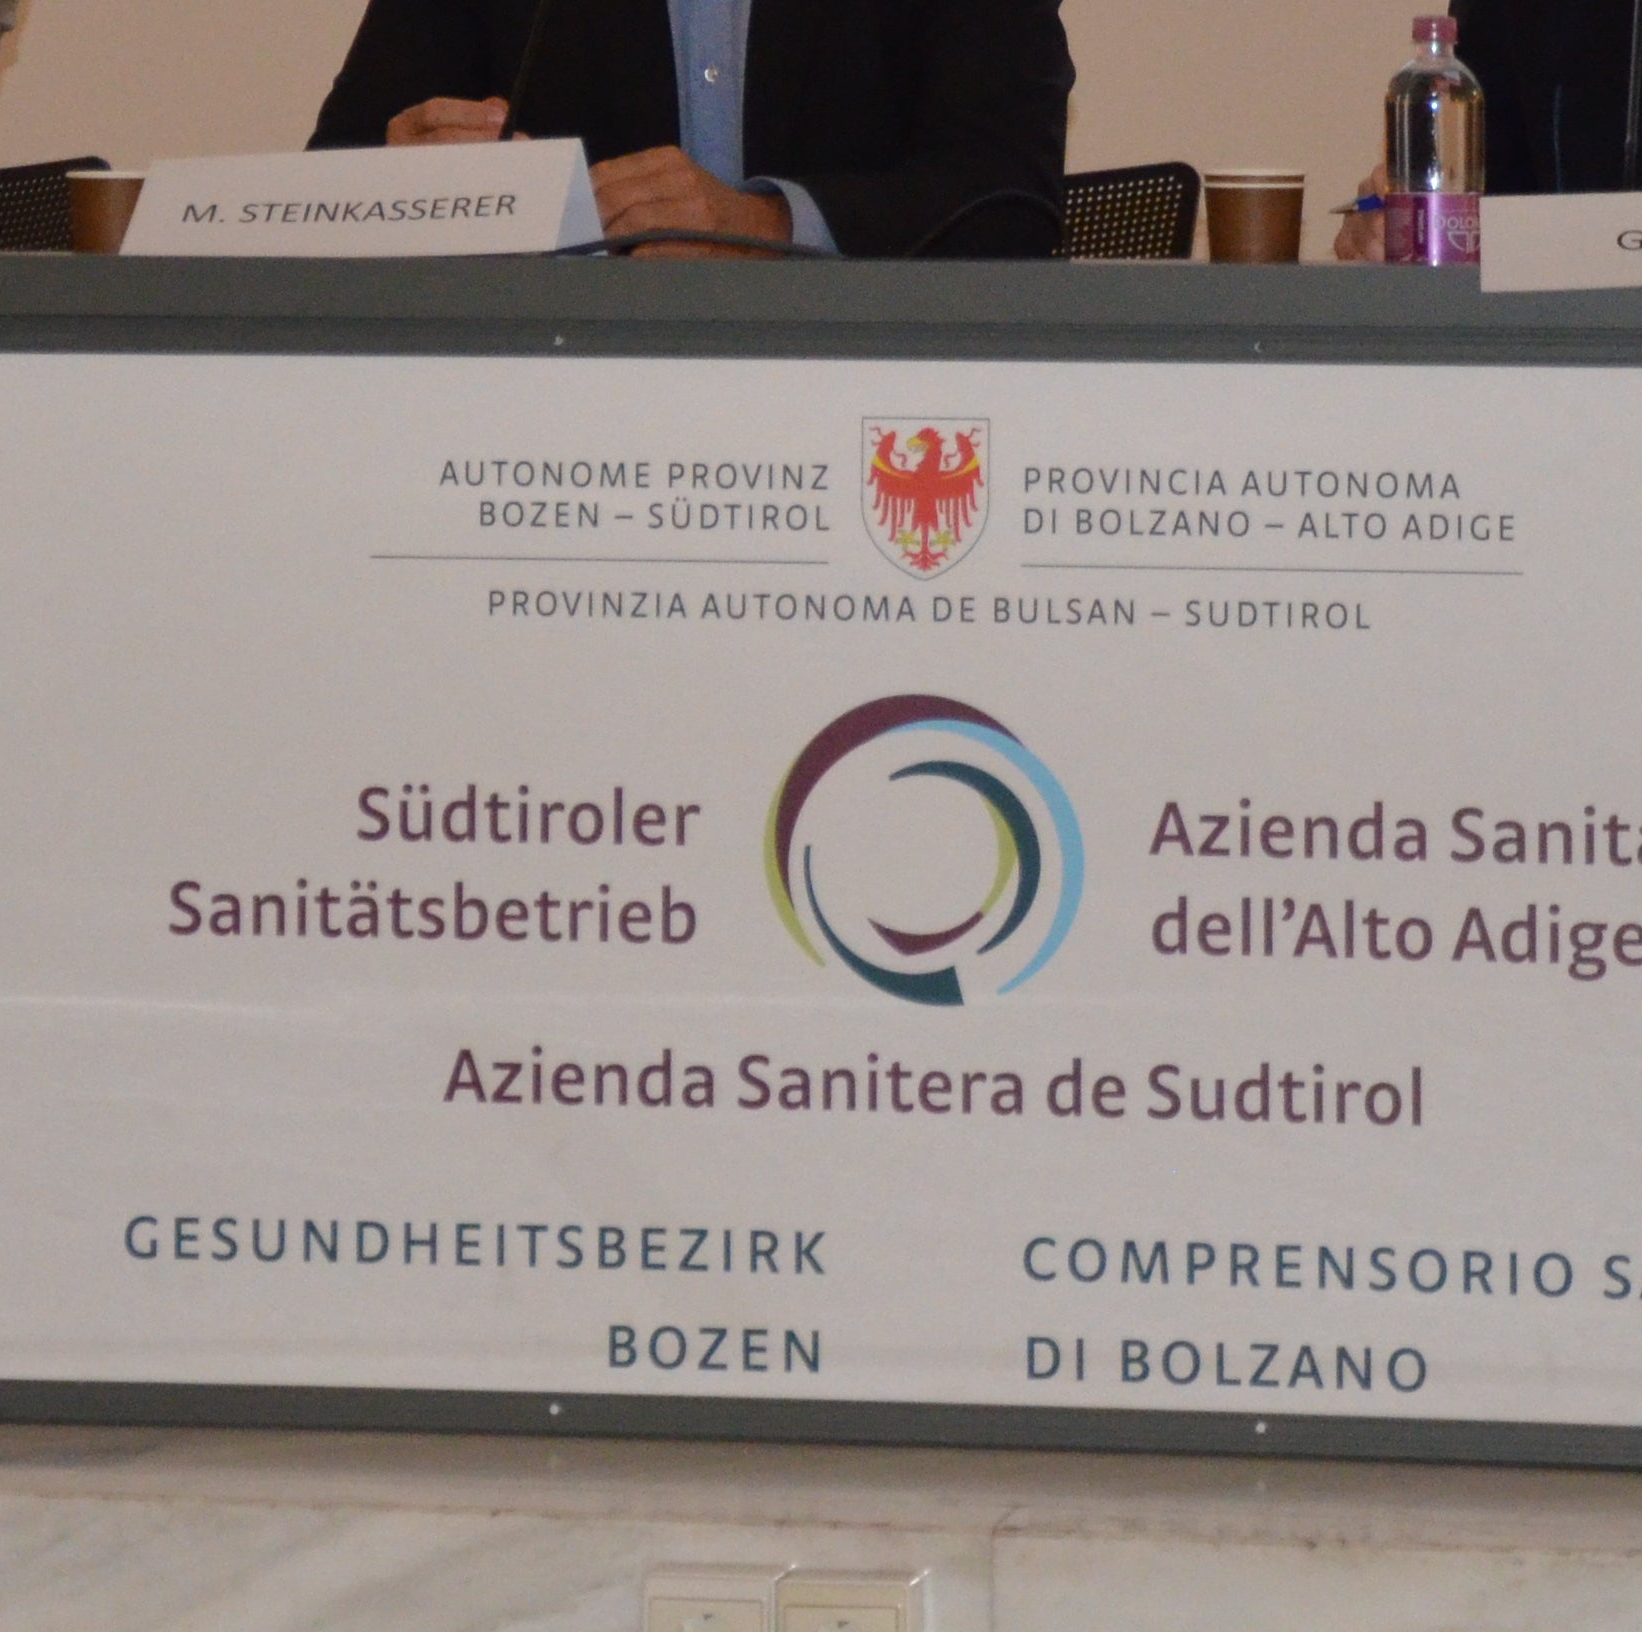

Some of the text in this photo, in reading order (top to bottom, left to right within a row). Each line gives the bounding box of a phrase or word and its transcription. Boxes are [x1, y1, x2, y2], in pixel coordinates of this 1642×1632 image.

[180, 194, 517, 225] M. STEINKASSERER
[439, 459, 829, 491] AUTONOME PROVINZ
[1024, 466, 1461, 499] PROVINCIA AUTONOMA
[479, 500, 599, 529] BOZEN
[647, 496, 830, 532] SÜDTIROL
[1023, 507, 1057, 535] DI
[1075, 507, 1250, 538] BOLZANO
[1297, 511, 1387, 541] ALTO
[1401, 513, 1514, 542] ADIGE
[488, 589, 687, 619] PROVINZIA
[700, 592, 916, 622] AUTONOMA
[932, 595, 975, 624] DE
[993, 596, 1135, 626] BULSAN
[1185, 599, 1371, 630] SUDTIROL
[357, 783, 701, 847] Südtiroler
[1149, 797, 1427, 862] Azienda
[169, 877, 697, 945] Sanitätsbetrieb
[443, 1044, 1422, 1126] Azienda Sanitera de Sudtirol
[124, 1215, 825, 1275] GESUNDHEITSBEZIRK
[1023, 1236, 1574, 1298] COMPRENSORIO
[608, 1324, 820, 1373] BOZEN
[1026, 1336, 1427, 1393] DI BOLZANO
